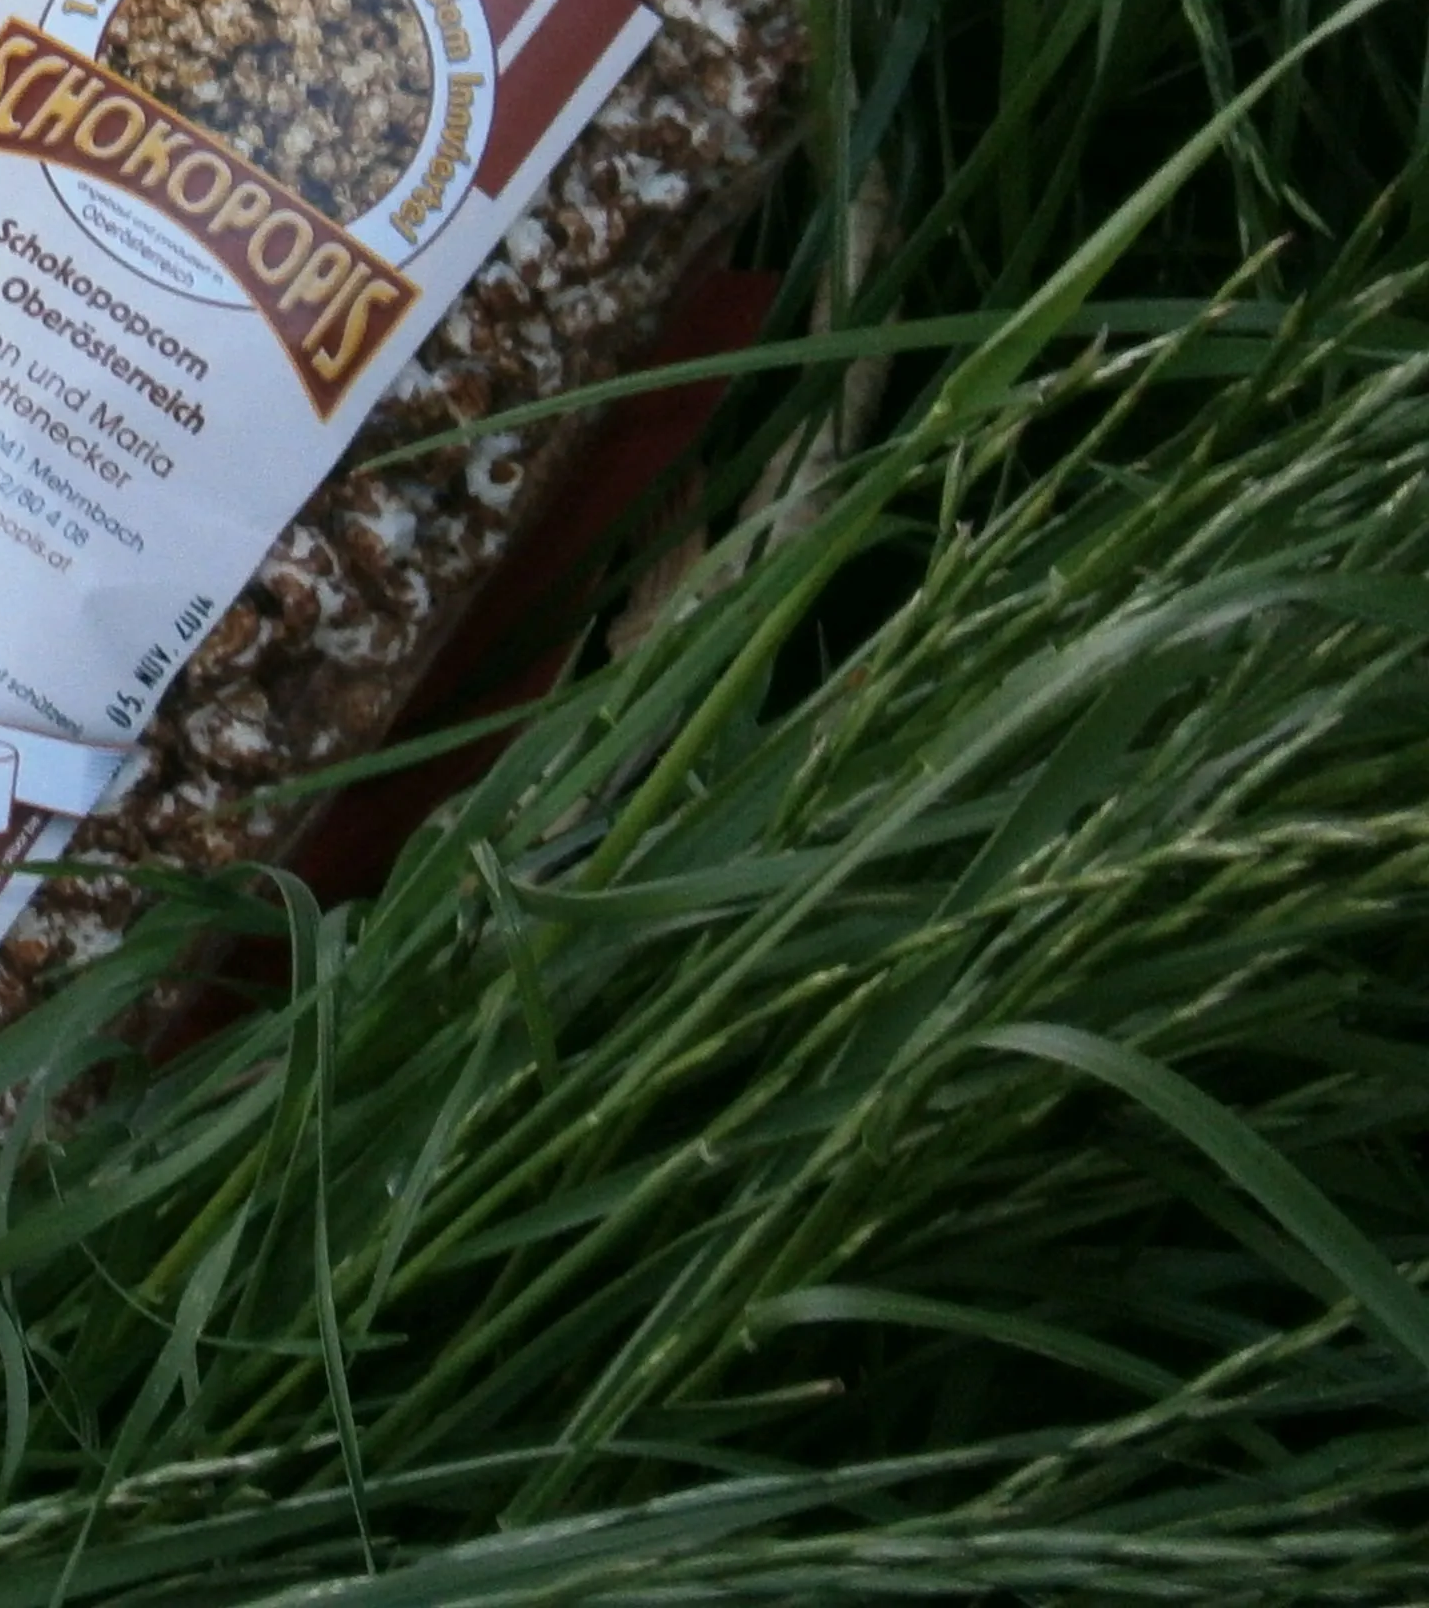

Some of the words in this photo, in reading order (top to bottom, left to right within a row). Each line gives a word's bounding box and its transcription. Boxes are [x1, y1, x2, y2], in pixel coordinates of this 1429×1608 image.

[388, 70, 485, 245] Innviertel
[0, 274, 209, 433] Oberösterreich
[27, 358, 90, 410] und
[89, 403, 177, 477] Maria
[27, 458, 147, 553] Mehrnbach
